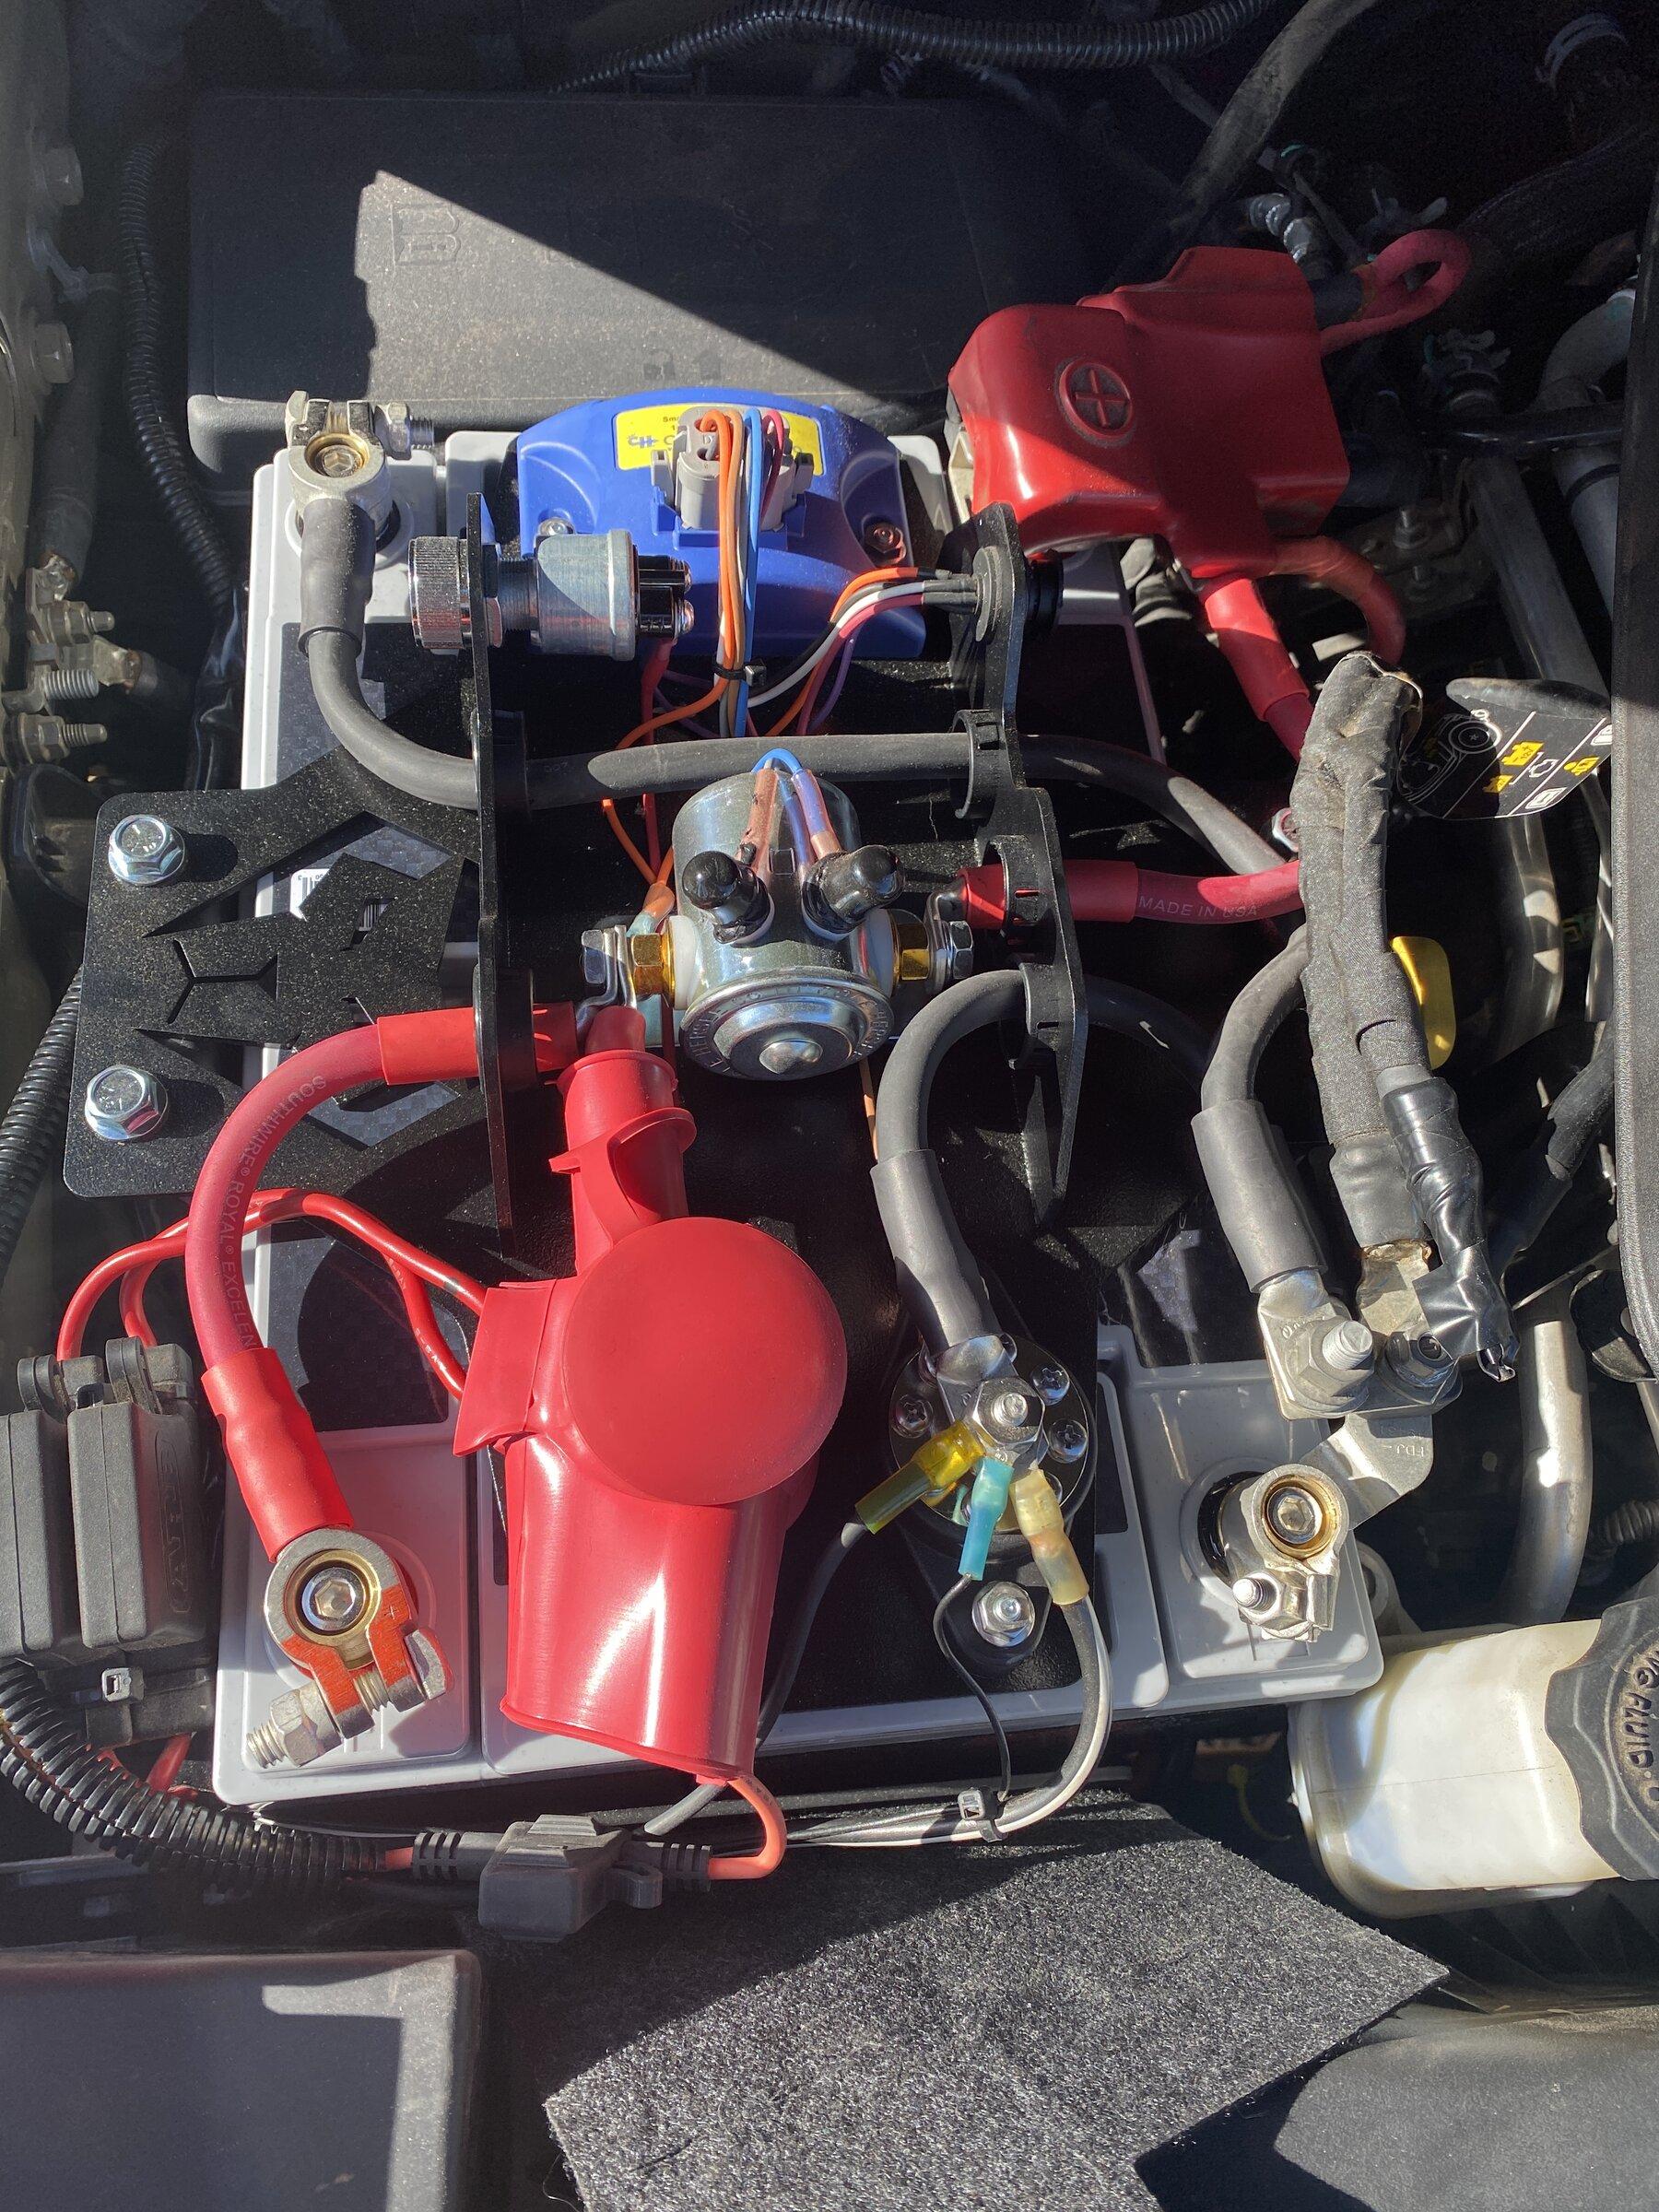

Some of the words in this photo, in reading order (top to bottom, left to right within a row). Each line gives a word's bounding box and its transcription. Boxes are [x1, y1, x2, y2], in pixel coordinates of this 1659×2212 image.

[1139, 895, 1193, 916] MADE
[1198, 905, 1217, 917] IN
[1222, 905, 1258, 918] USA
[1620, 1691, 1654, 1769] FLUID
